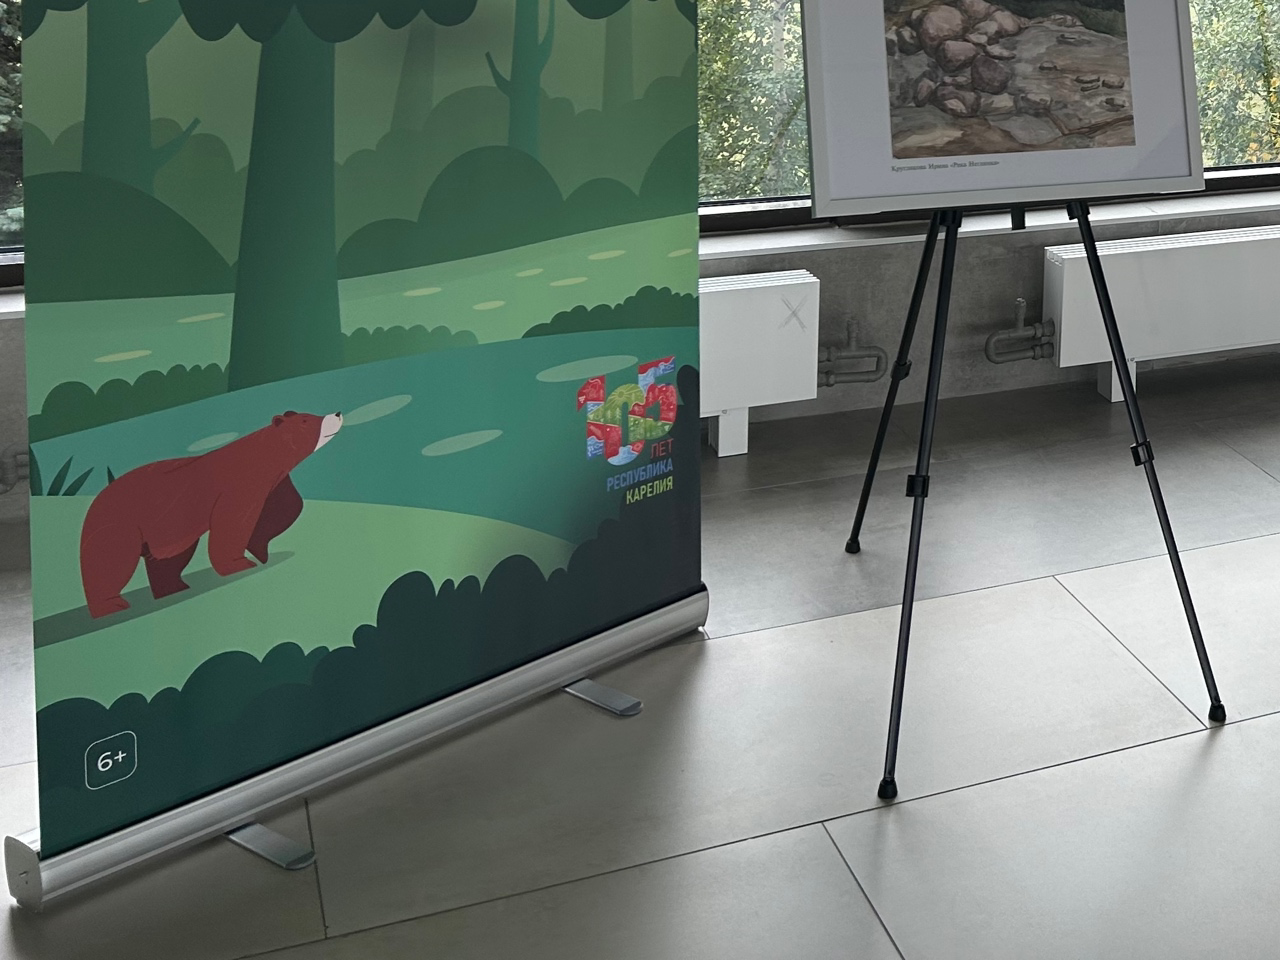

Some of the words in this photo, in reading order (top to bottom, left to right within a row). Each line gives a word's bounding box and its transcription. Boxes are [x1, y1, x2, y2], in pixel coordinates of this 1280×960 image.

[650, 438, 675, 459] ЛЕТ
[606, 457, 675, 493] РЕСПУБЛИКА
[625, 475, 674, 505] КАРЕЛИЯ
[97, 750, 128, 772] 6+
